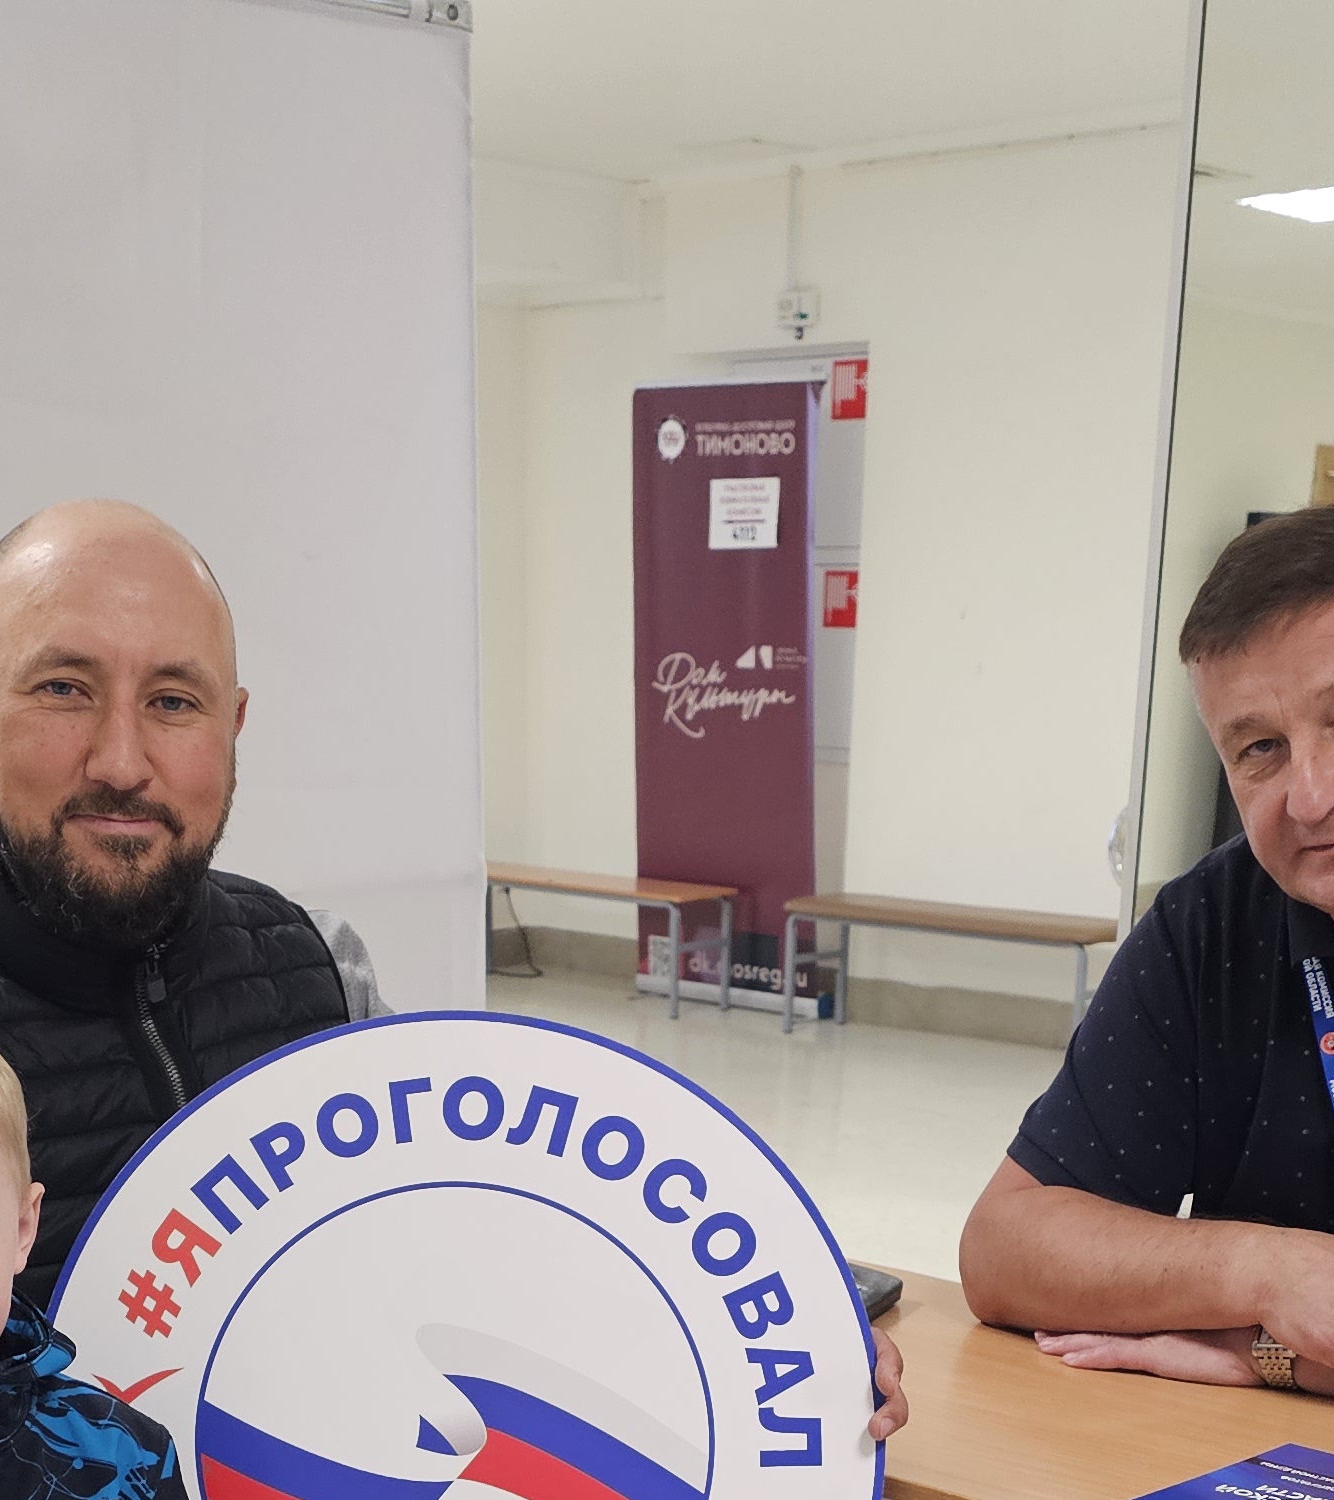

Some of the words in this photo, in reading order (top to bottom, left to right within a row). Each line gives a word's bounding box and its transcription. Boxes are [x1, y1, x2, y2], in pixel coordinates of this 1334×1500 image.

[695, 432, 796, 457] ТИМОНОВО
[651, 651, 728, 693] Дом
[662, 685, 796, 739] Культуры
[1305, 972, 1323, 1012] ОБЛАСТИ
[1314, 970, 1334, 1019] КОМИССИЯ
[116, 1075, 824, 1469] #ЯПРОГОЛОСОВАЛ
